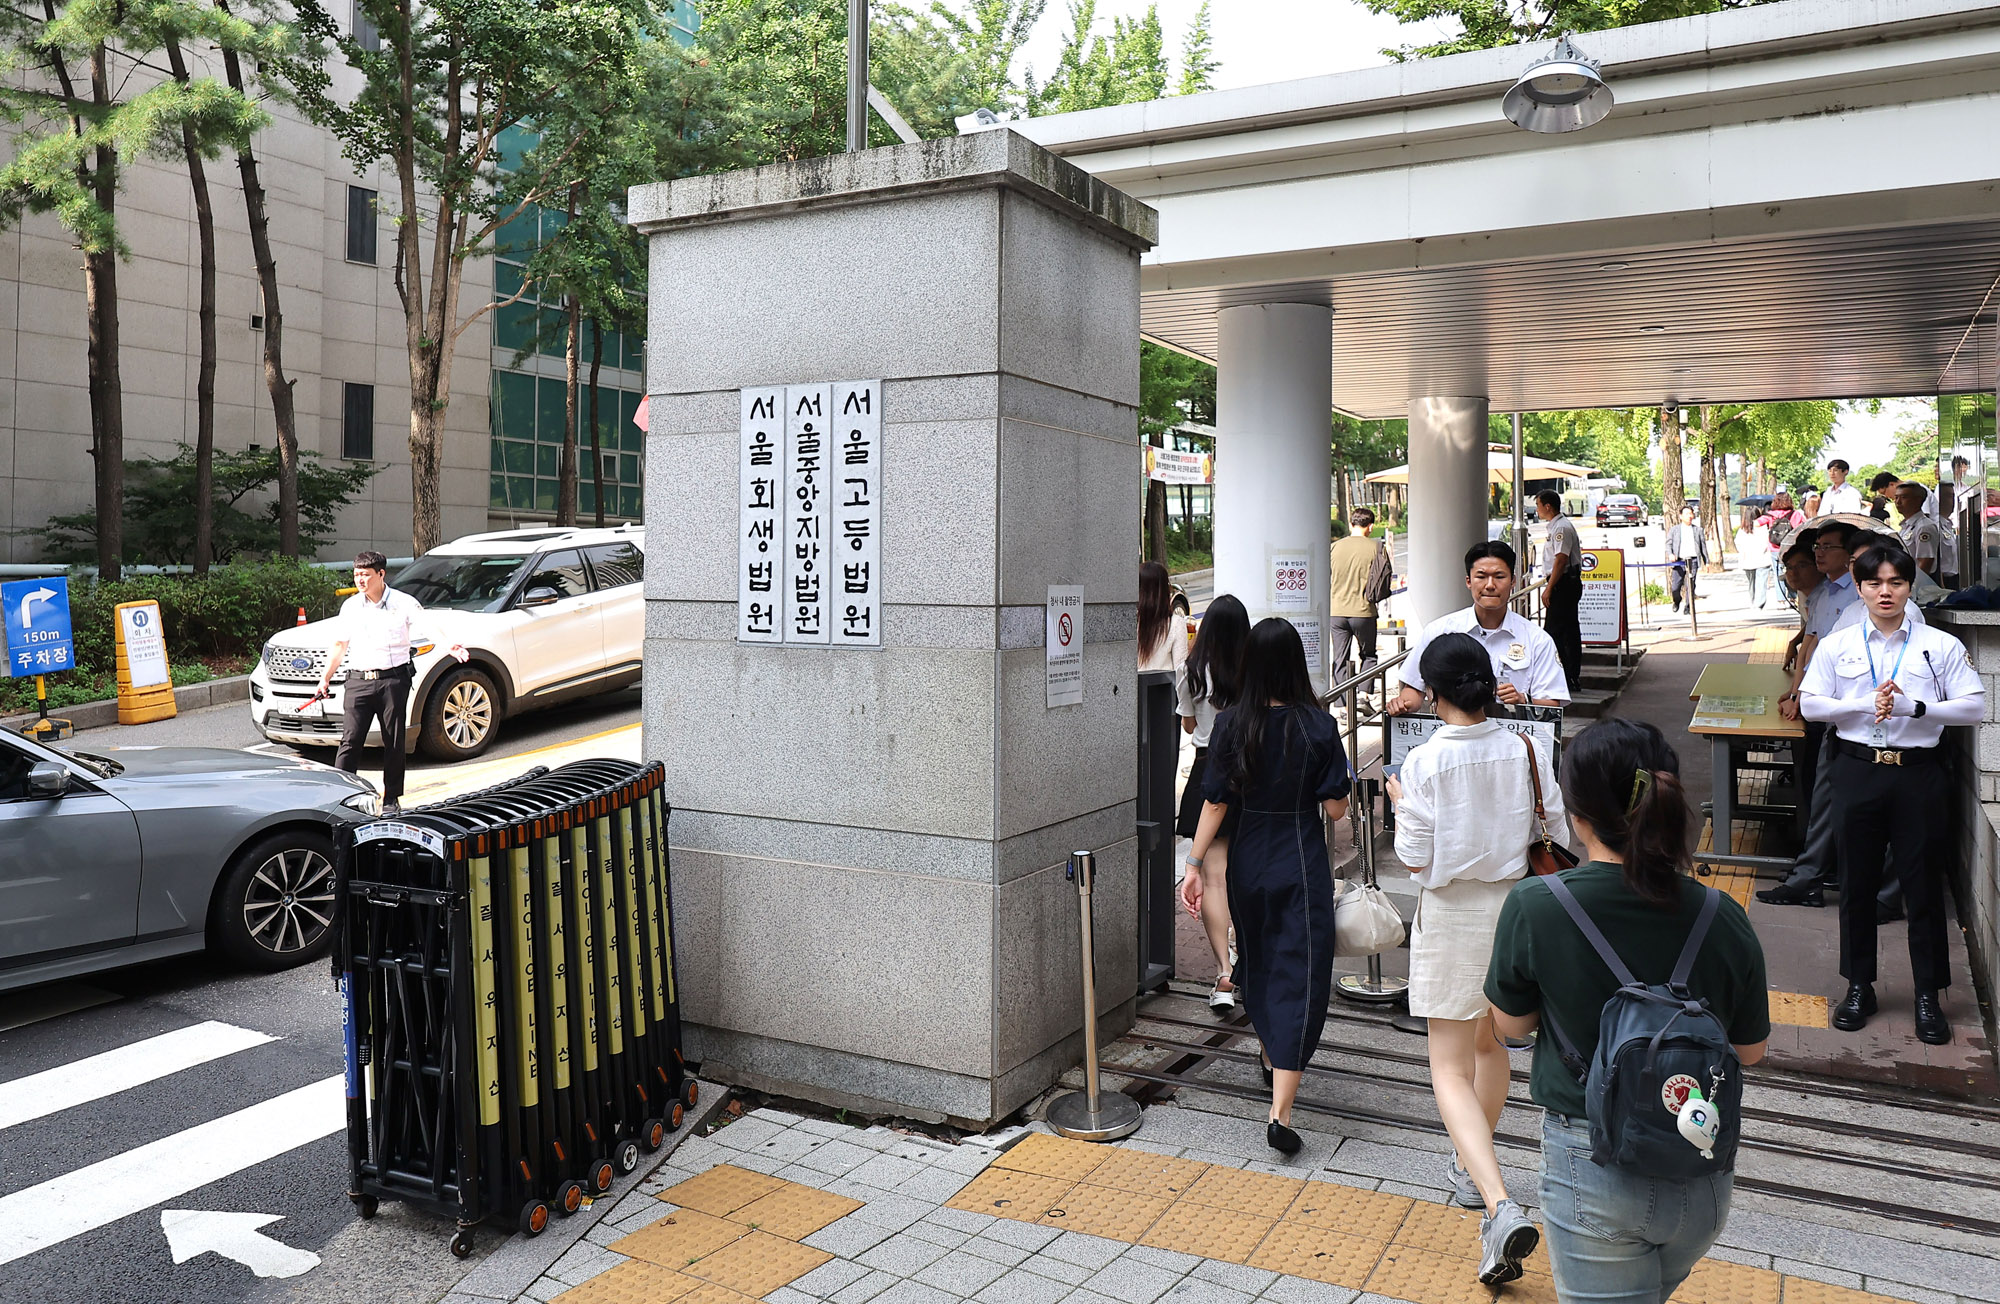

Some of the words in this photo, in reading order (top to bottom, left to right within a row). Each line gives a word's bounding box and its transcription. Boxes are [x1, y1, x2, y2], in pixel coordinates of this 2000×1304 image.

[748, 395, 774, 634] 서울회생법원
[795, 393, 821, 635] 서울중앙지방법원
[843, 388, 870, 638] 서울고등법원
[17, 646, 68, 669] 주차장
[23, 630, 60, 644] 150m
[1398, 721, 1423, 737] 법원
[523, 893, 534, 993] POLICE
